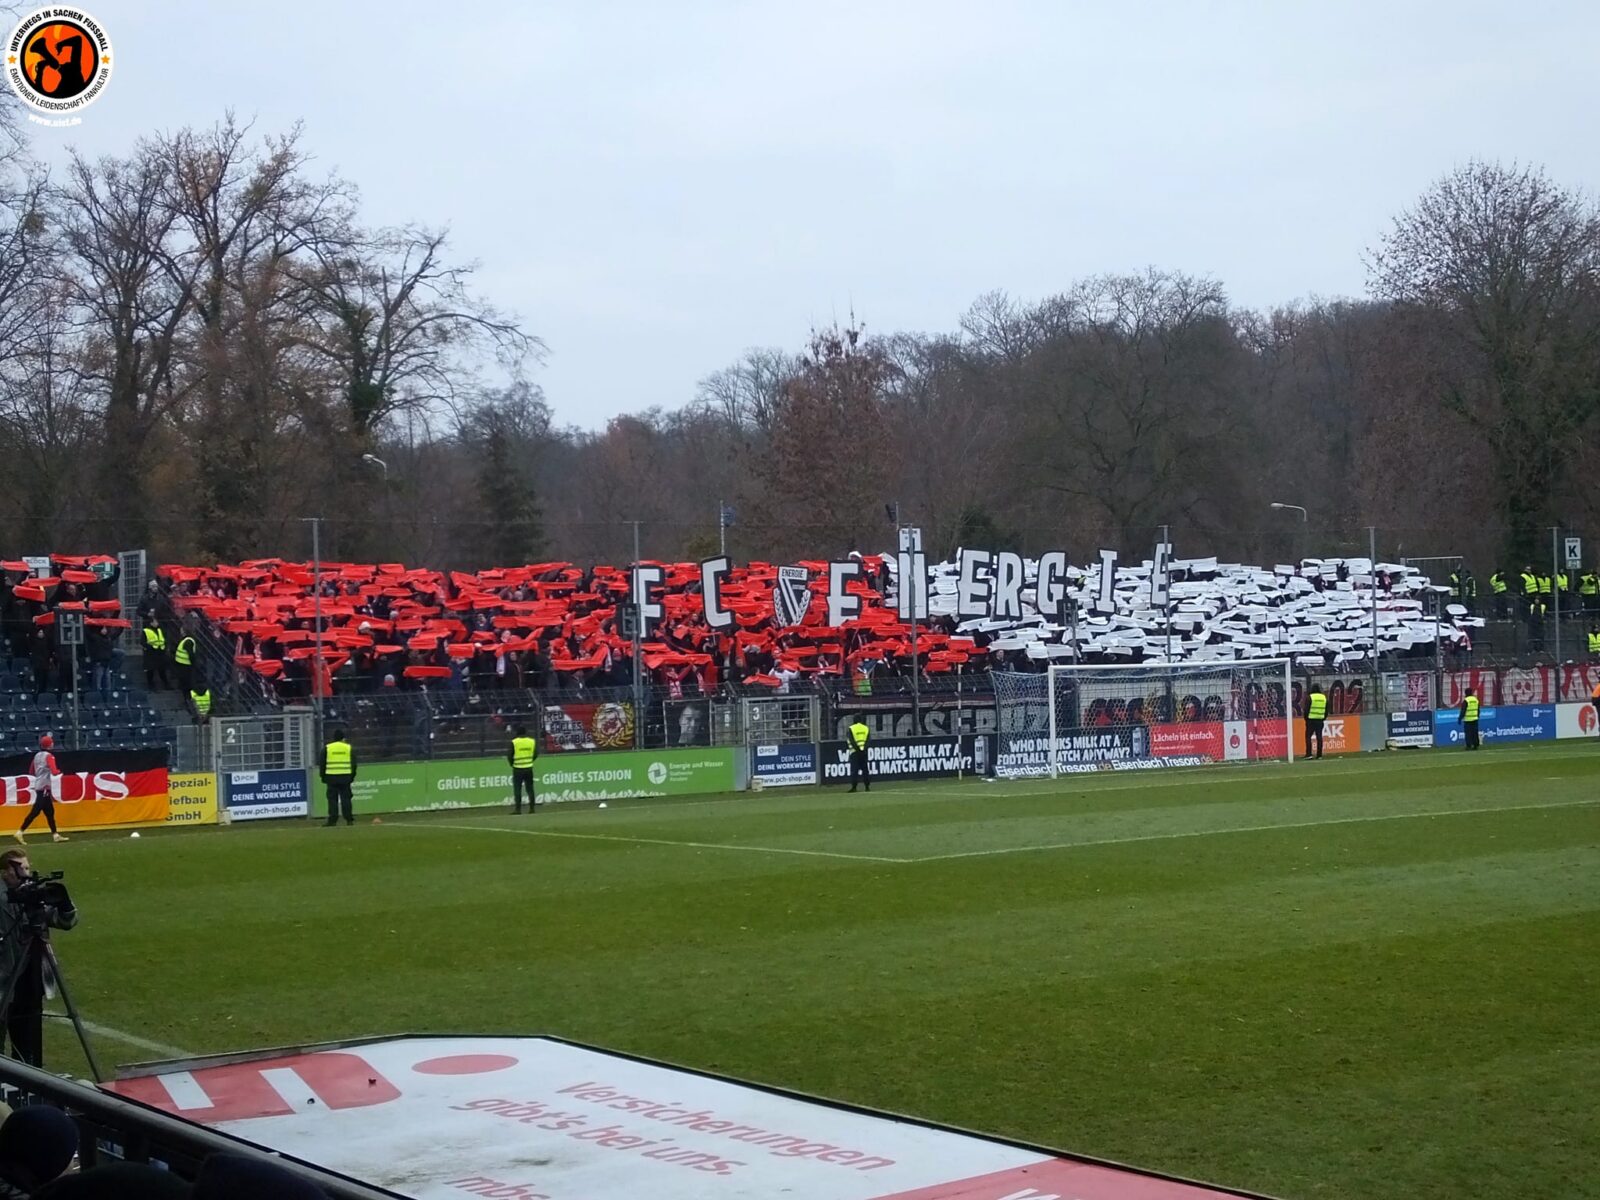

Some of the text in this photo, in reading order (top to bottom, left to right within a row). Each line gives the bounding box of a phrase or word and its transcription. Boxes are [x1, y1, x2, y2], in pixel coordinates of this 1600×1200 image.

[1568, 545, 1578, 557] K
[753, 707, 759, 720] 3
[226, 728, 235, 743] 2
[1154, 732, 1179, 742] Lächeln
[1180, 732, 1188, 741] ist
[1009, 735, 1120, 752] WHO DRNKS MILK AT A
[867, 746, 906, 760] DRINKS
[909, 745, 935, 759] MILK
[938, 744, 952, 757] AT
[997, 751, 1046, 766] FOOTBALL
[825, 756, 971, 777] FOOTLL MATCH ANYWAY?
[1056, 762, 1097, 774] Tresore
[1111, 758, 1163, 770] Eisenbach
[1162, 756, 1200, 768] Tresore
[437, 776, 476, 790] GRÜNE
[543, 770, 584, 785] GRÜNES
[587, 768, 632, 783] STADION
[262, 782, 300, 792] DEIN STYLE
[169, 795, 206, 806] iefbau
[232, 790, 301, 801] DEINE WORKWEAR
[233, 805, 301, 816] www.pch-shop.de
[555, 1080, 897, 1171] Versicherungen
[449, 1098, 747, 1176] gibt's bei uns.
